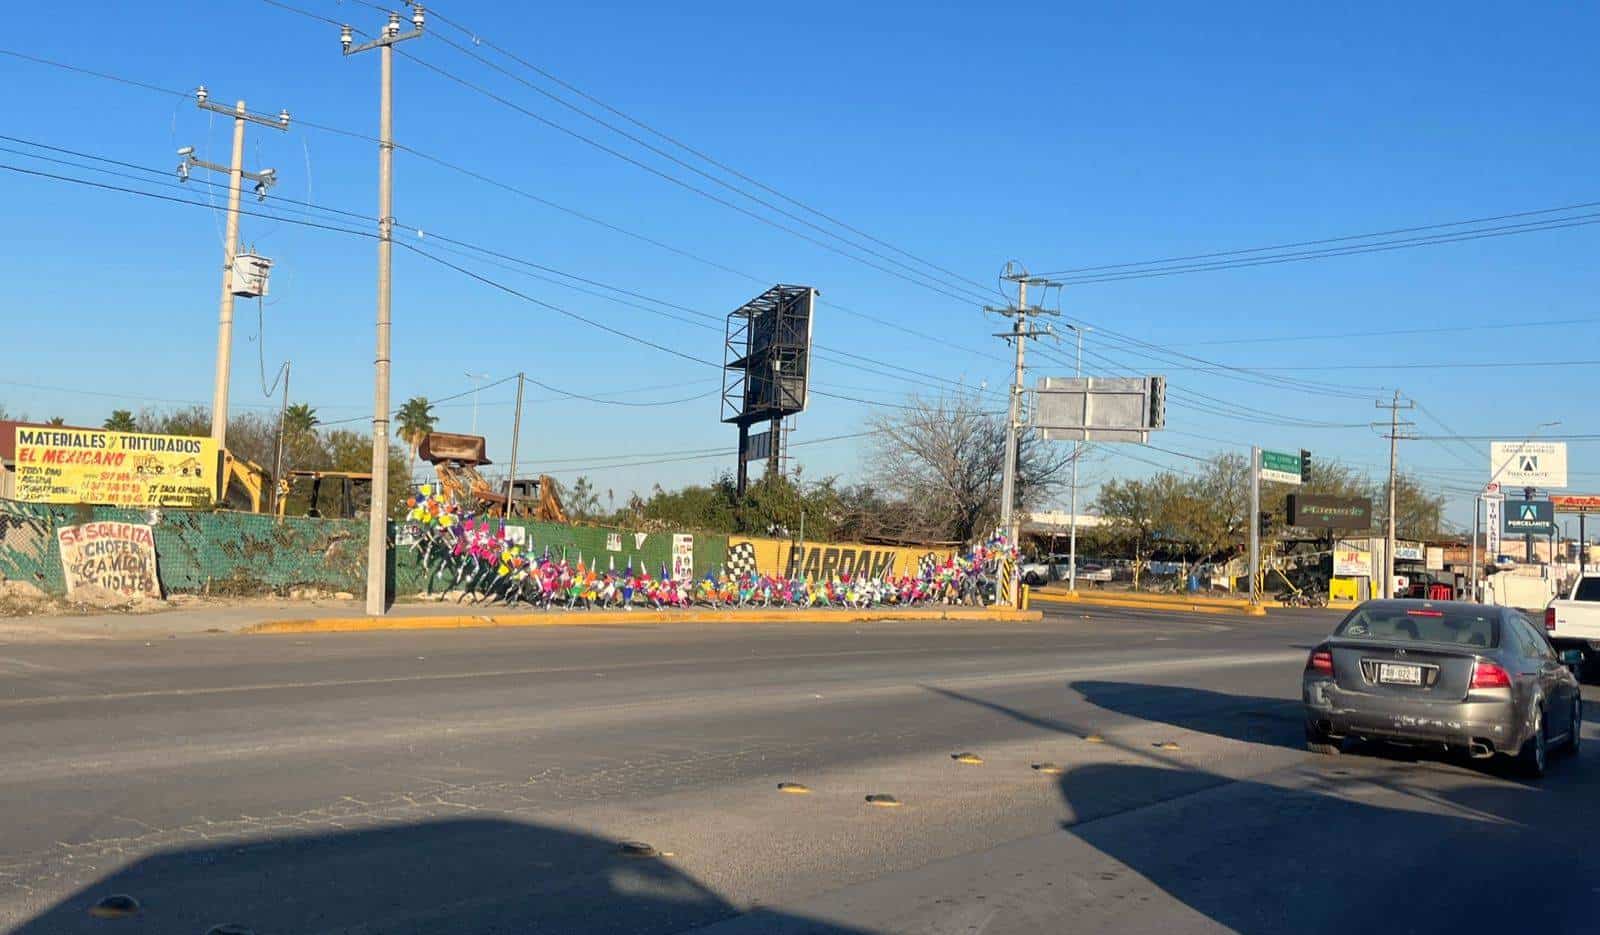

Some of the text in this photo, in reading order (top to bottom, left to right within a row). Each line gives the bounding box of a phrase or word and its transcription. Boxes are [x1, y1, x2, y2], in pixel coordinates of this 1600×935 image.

[19, 430, 106, 449] MATERIALES
[120, 435, 201, 454] TRITURADOS
[18, 447, 126, 467] EL MEXICANO
[60, 523, 155, 547] SE SOLICITA
[85, 540, 139, 557] CHOFER
[784, 545, 896, 583] BARDAH
